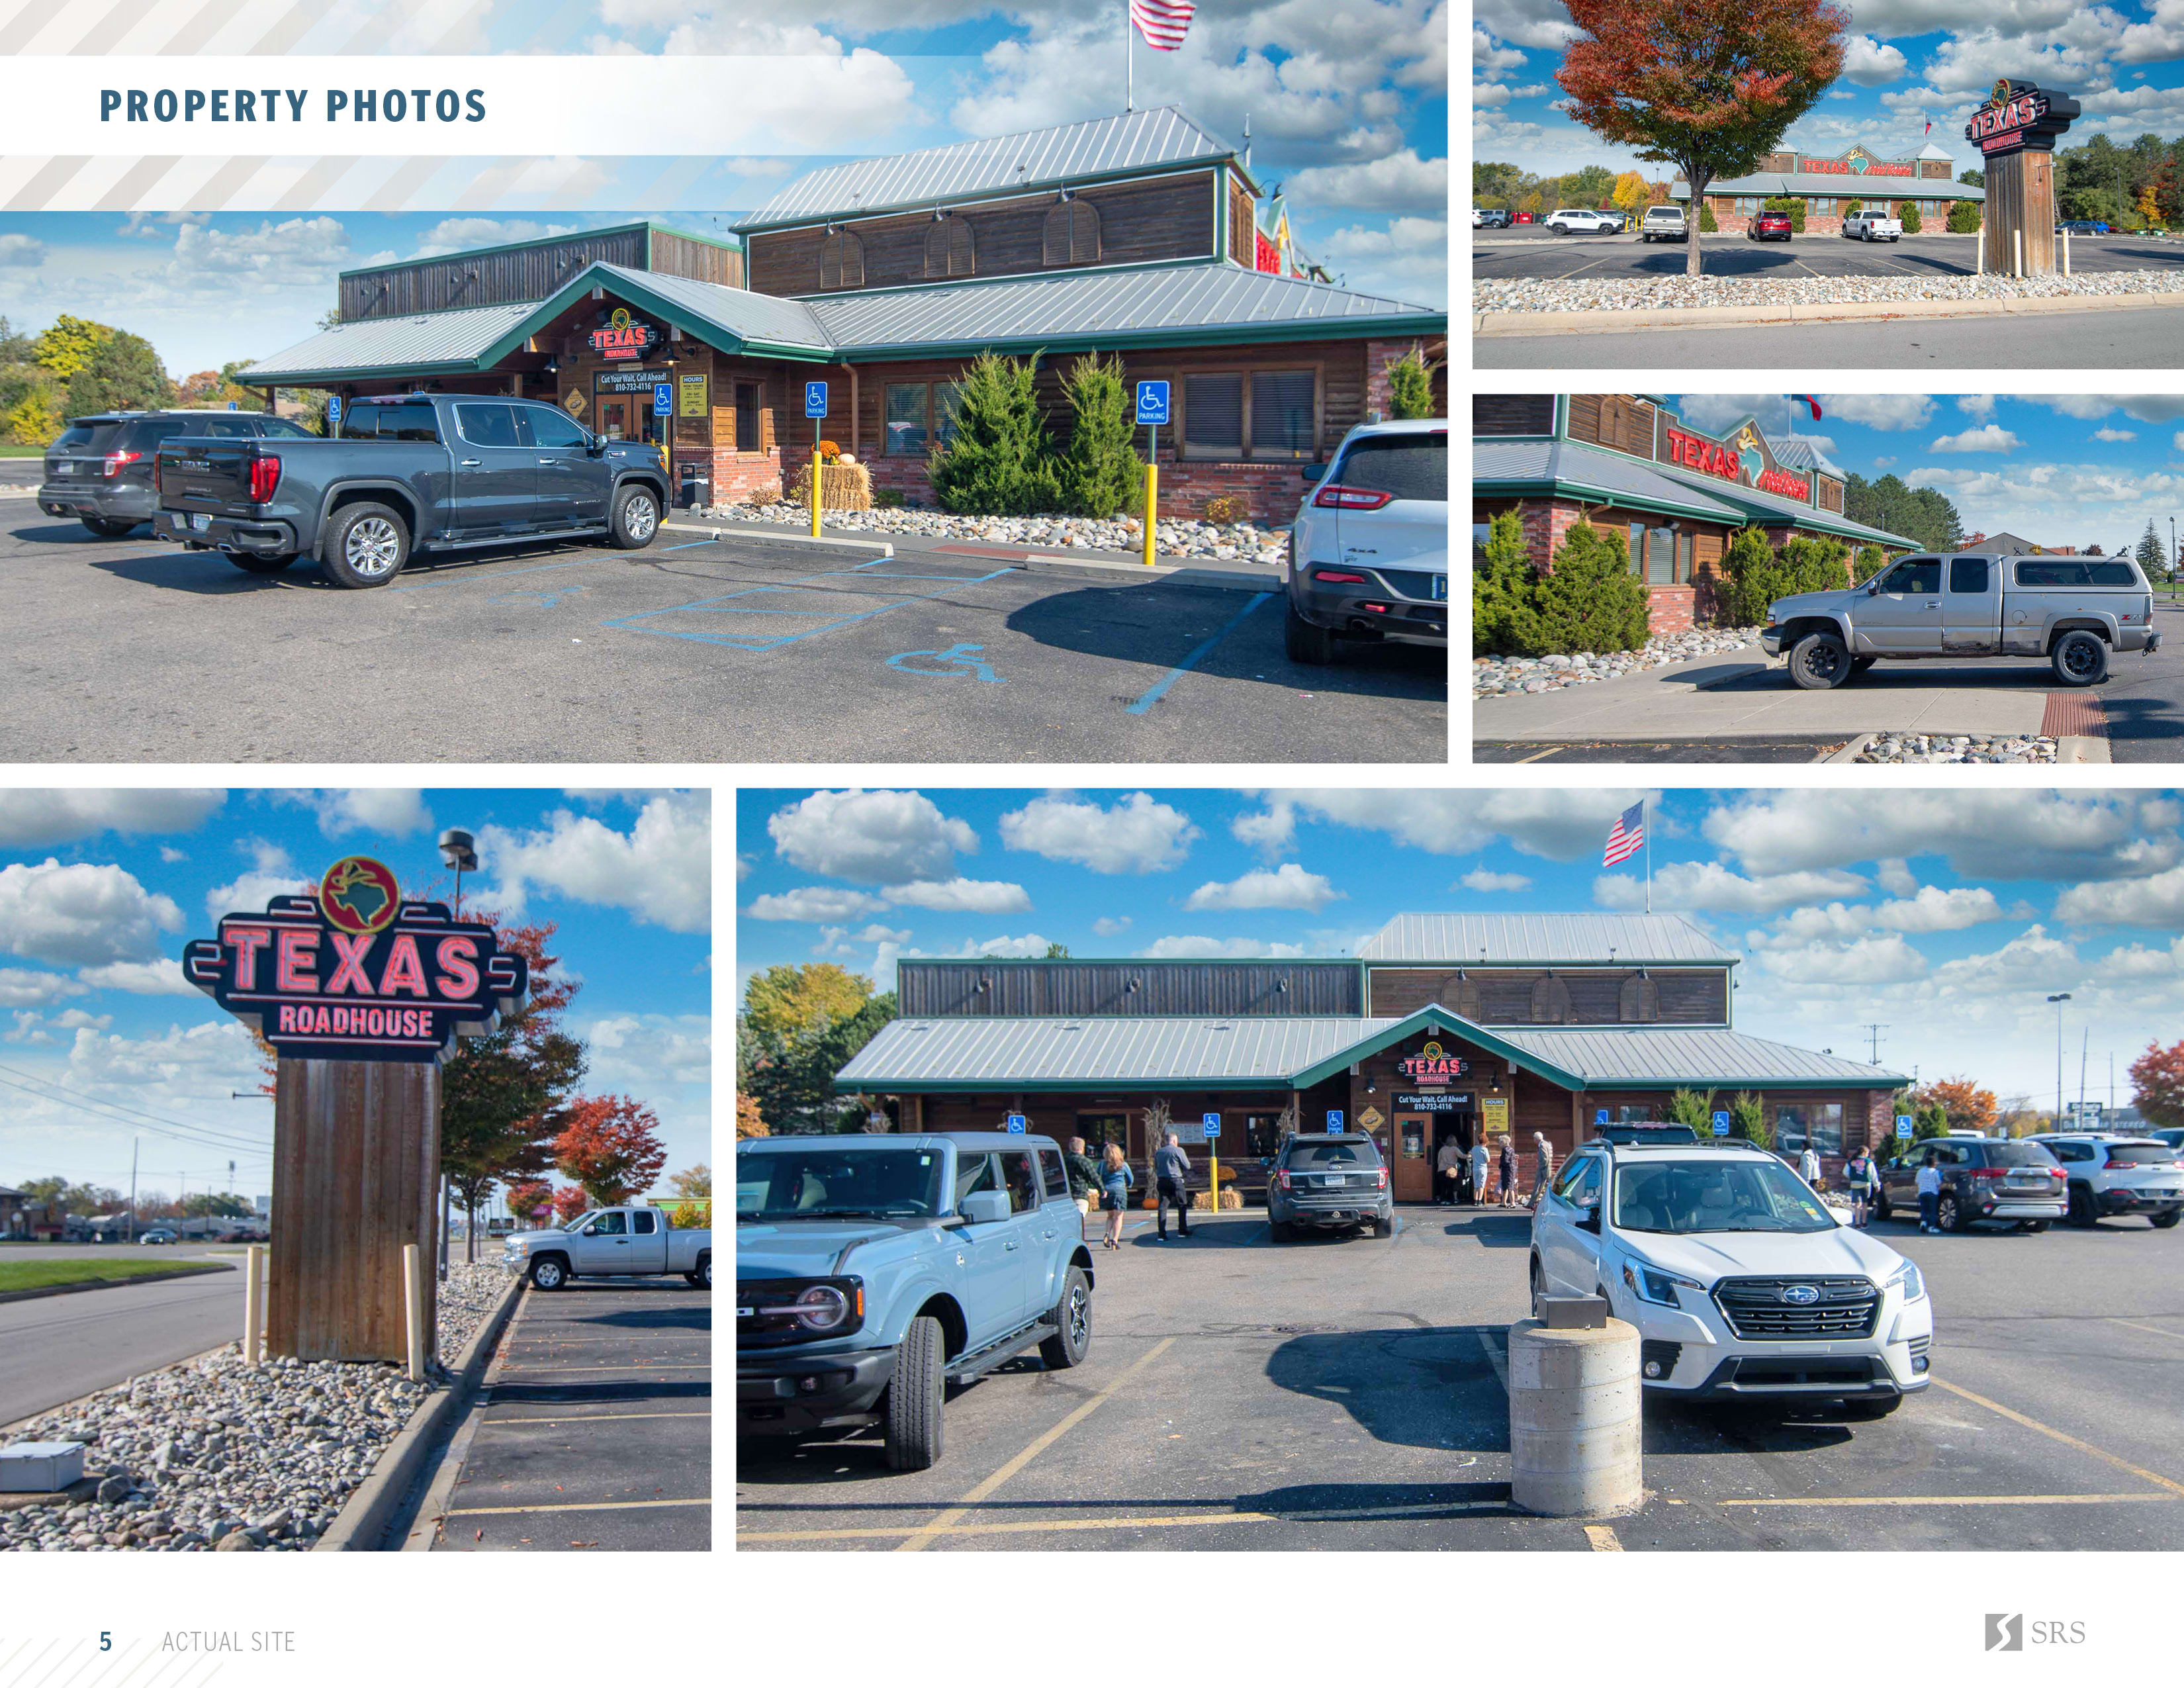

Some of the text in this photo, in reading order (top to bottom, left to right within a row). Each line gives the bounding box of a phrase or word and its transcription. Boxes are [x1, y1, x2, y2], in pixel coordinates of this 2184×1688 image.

[1970, 97, 2036, 139] TEXAS
[1803, 160, 1848, 173] TEXAS
[593, 327, 645, 348] TEXAS
[615, 383, 651, 391] 810-732-4116
[1668, 428, 1738, 479] TEXAS
[223, 928, 479, 1000] TEXAS
[279, 1004, 433, 1038] ROADHOUSE
[1405, 1059, 1460, 1074] TEXAS
